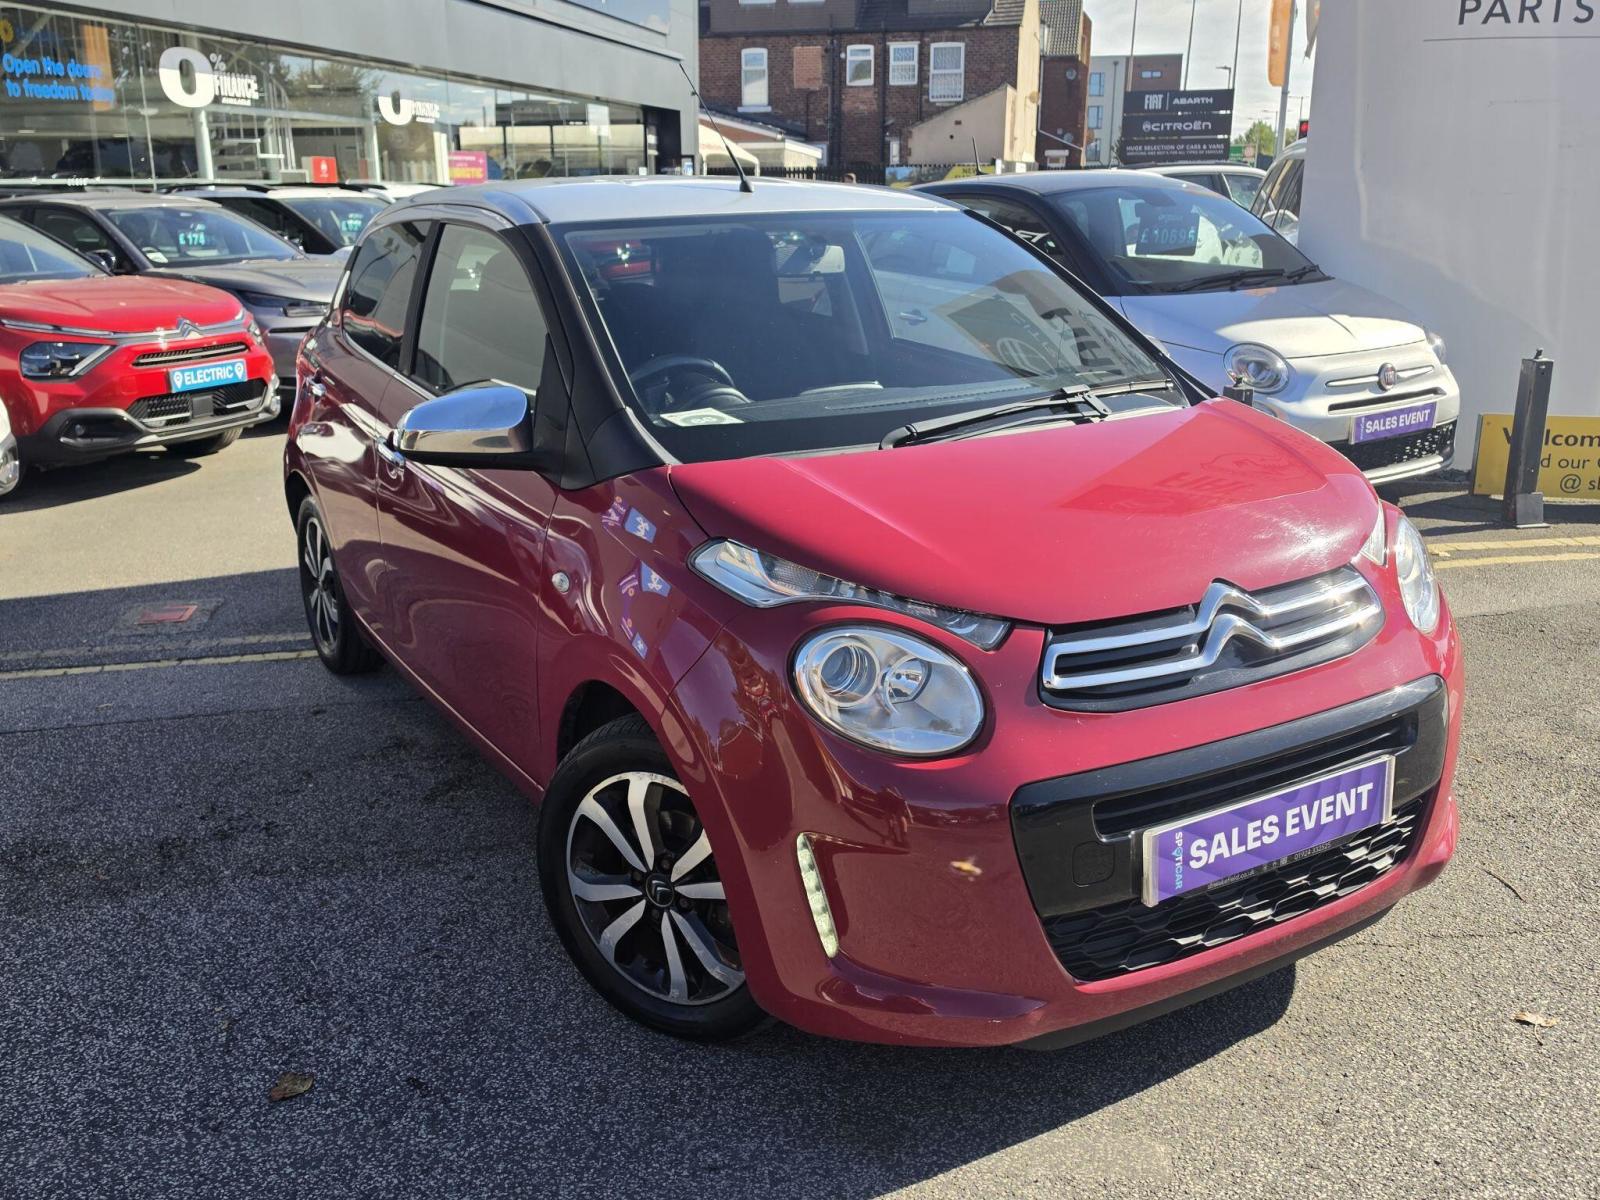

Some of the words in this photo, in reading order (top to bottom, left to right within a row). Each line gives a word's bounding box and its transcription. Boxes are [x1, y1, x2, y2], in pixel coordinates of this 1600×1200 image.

[2, 53, 40, 77] Open
[42, 56, 65, 76] the
[5, 78, 21, 97] to
[22, 78, 79, 100] freedom
[1144, 94, 1164, 110] FIAT
[1173, 97, 1213, 105] ABARTH
[184, 366, 234, 385] ELECTRIC
[1365, 416, 1398, 433] SALES
[1398, 409, 1431, 427] EVENT
[1558, 458, 1590, 469] our
[1560, 473, 1581, 494] @
[1189, 814, 1280, 870] SALES
[1285, 782, 1374, 837] EVENT
